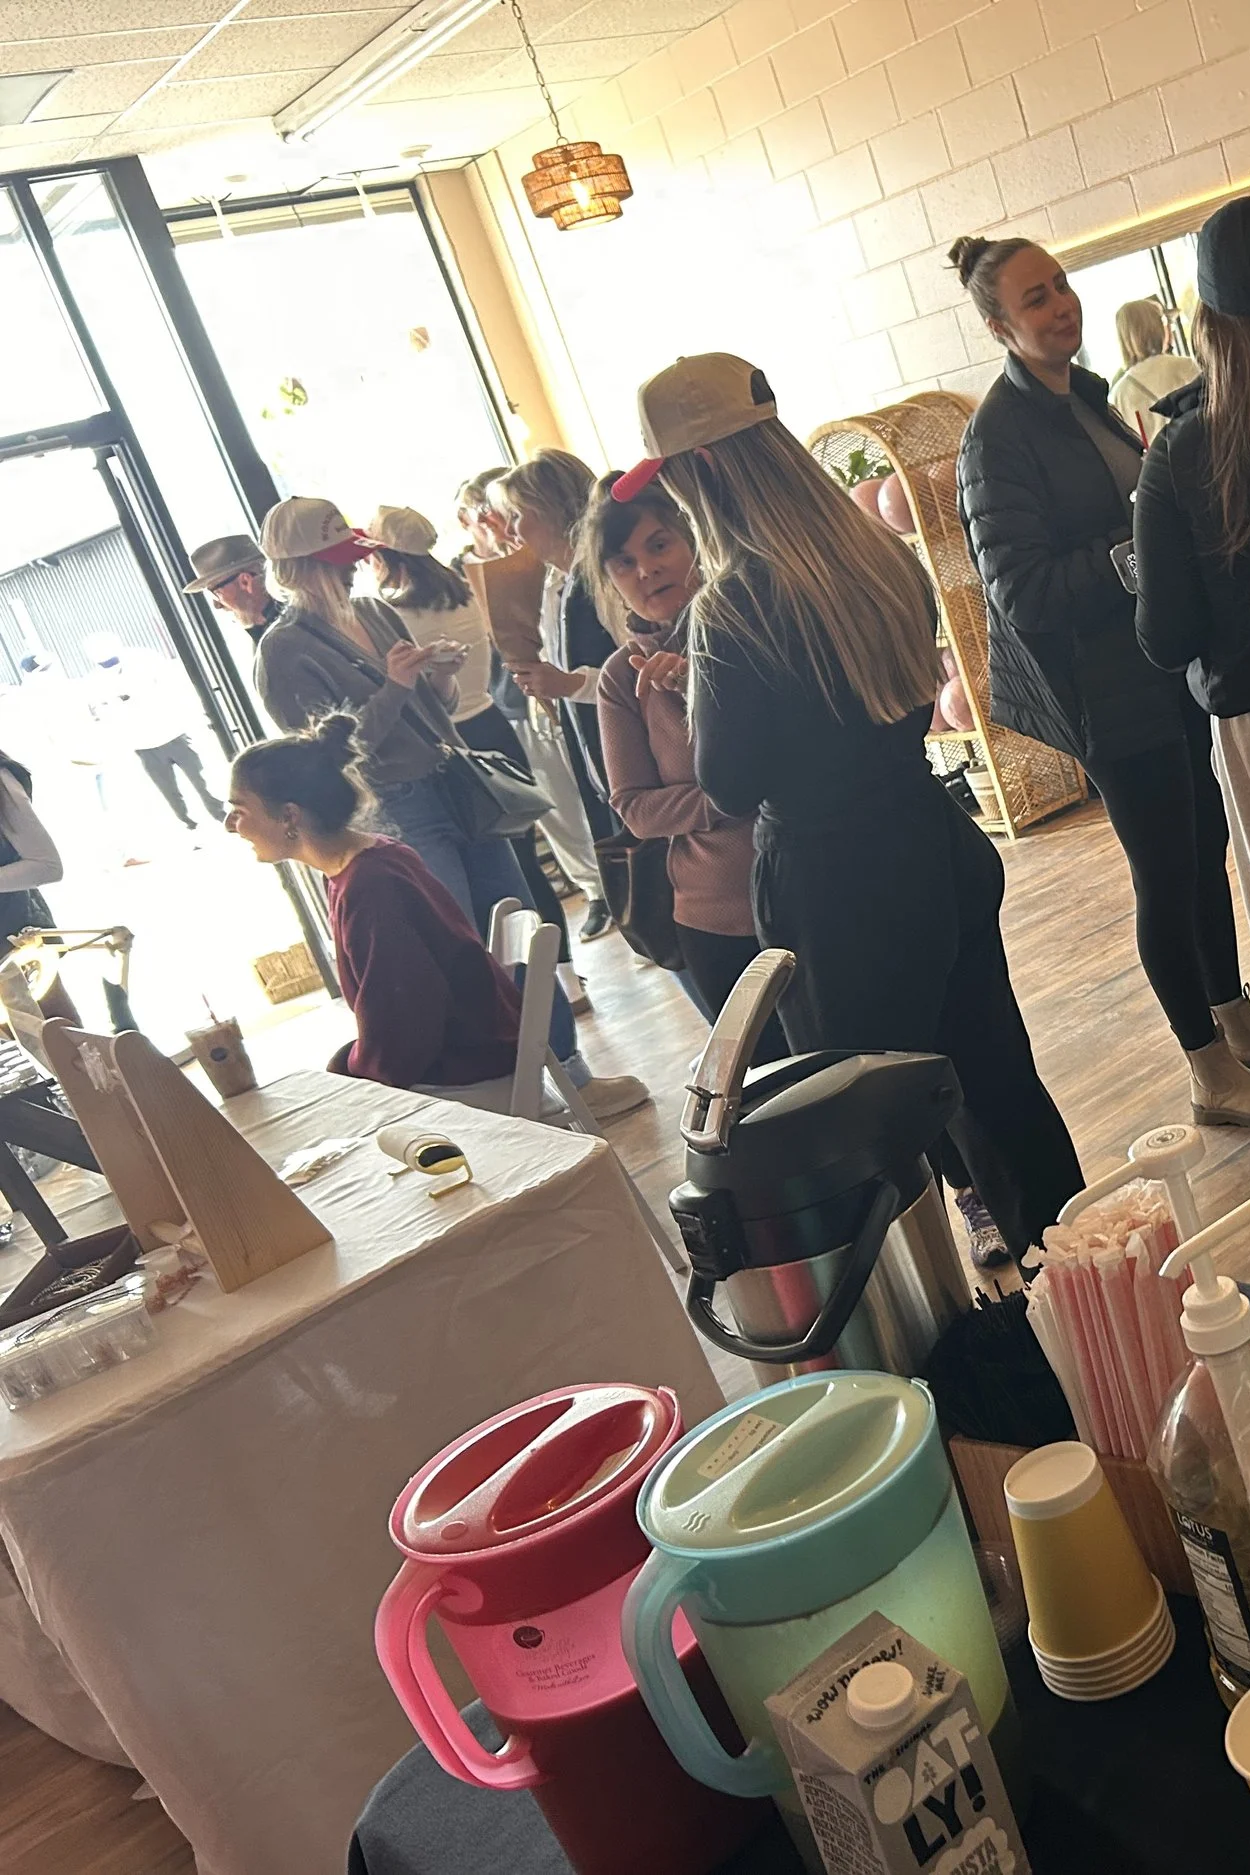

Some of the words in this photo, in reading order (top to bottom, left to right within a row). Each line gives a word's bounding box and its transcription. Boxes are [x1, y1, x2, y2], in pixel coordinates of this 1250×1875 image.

[1176, 1511, 1213, 1541] LOTUS
[863, 1764, 886, 1786] THE
[902, 1763, 986, 1868] LY!
